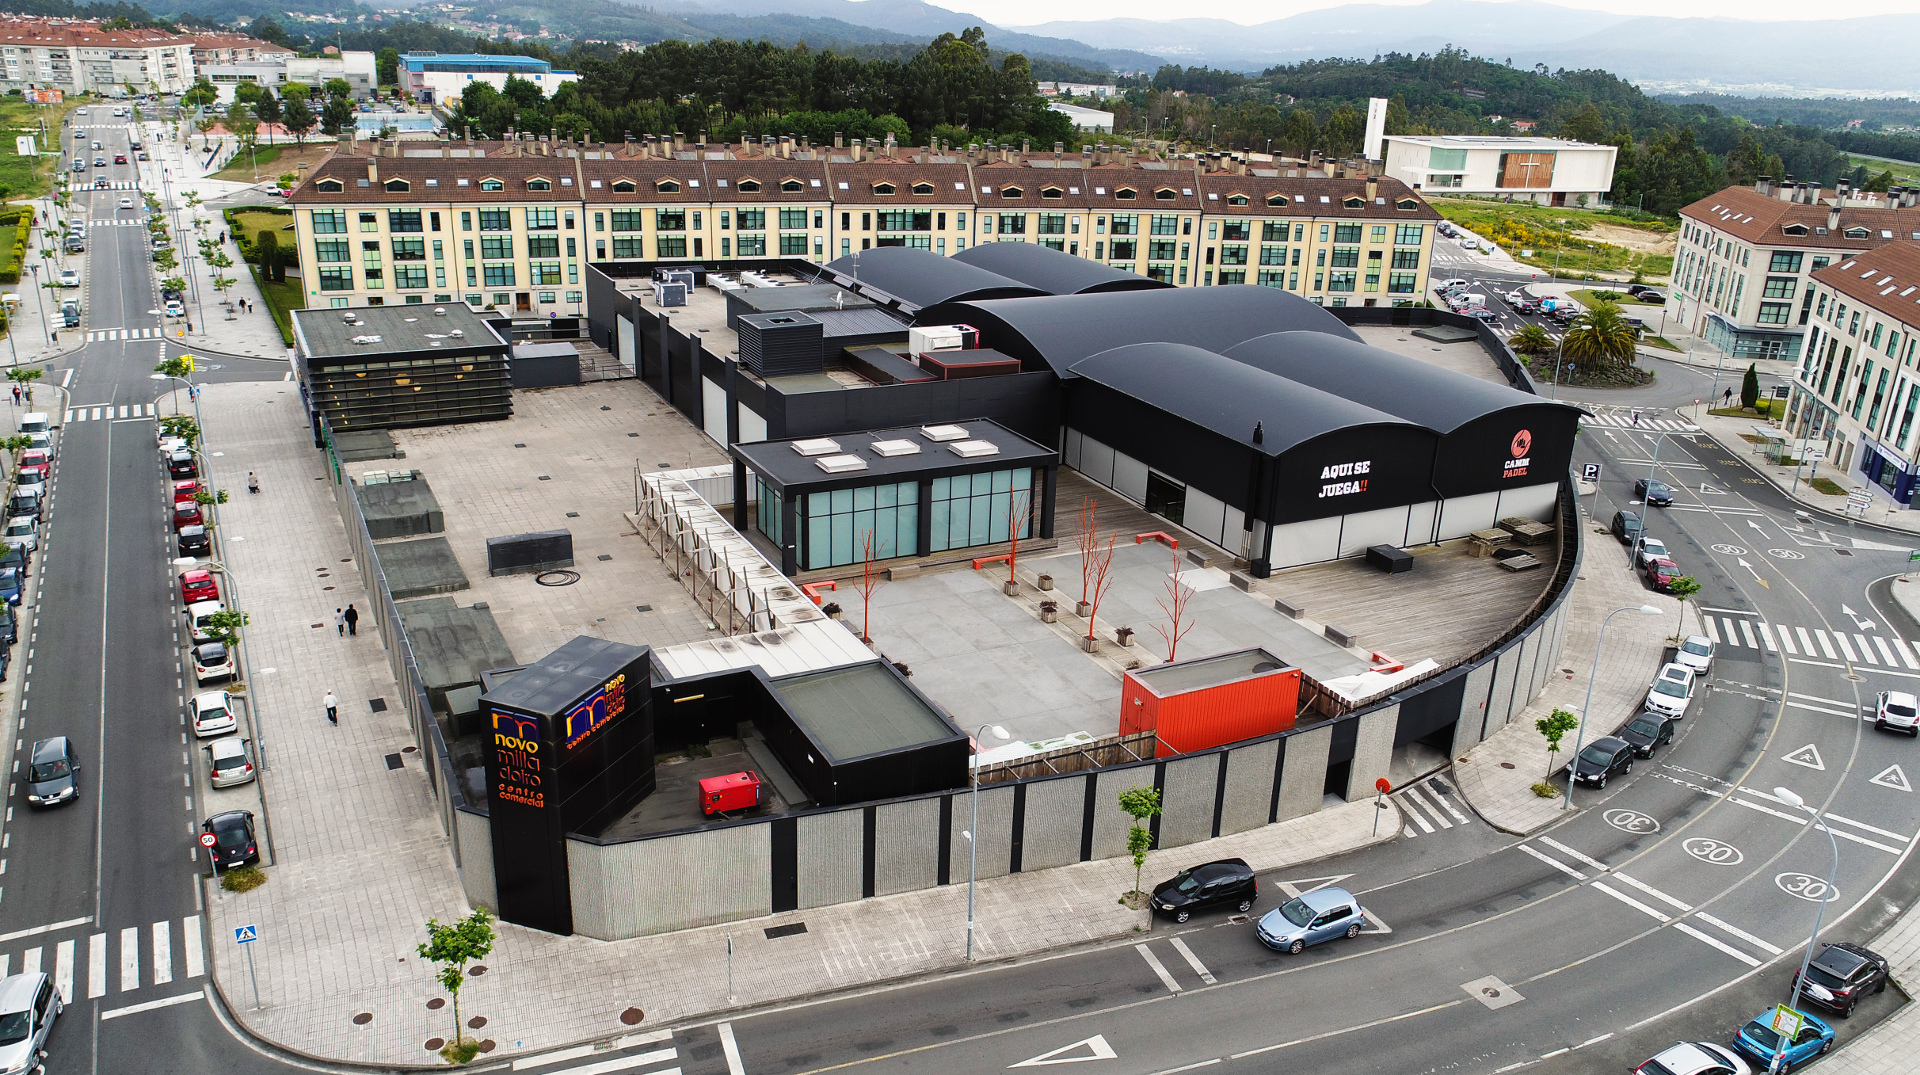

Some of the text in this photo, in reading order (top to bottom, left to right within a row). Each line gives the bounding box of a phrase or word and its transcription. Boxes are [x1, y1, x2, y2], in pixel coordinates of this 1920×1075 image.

[1320, 460, 1371, 480] AQUI SE
[1504, 457, 1531, 469] CAMM
[1585, 464, 1598, 477] P
[1502, 467, 1528, 479] PADEL
[1318, 479, 1368, 498] JUEGA!!
[604, 674, 625, 692] novo
[566, 704, 624, 749] centro comercial
[495, 733, 538, 753] novo
[497, 749, 539, 771] milla
[498, 783, 543, 799] centro
[499, 791, 543, 808] comercial
[1613, 812, 1650, 830] 30
[203, 836, 213, 844] 50
[1693, 841, 1732, 860] 30
[1786, 876, 1827, 897] 30
